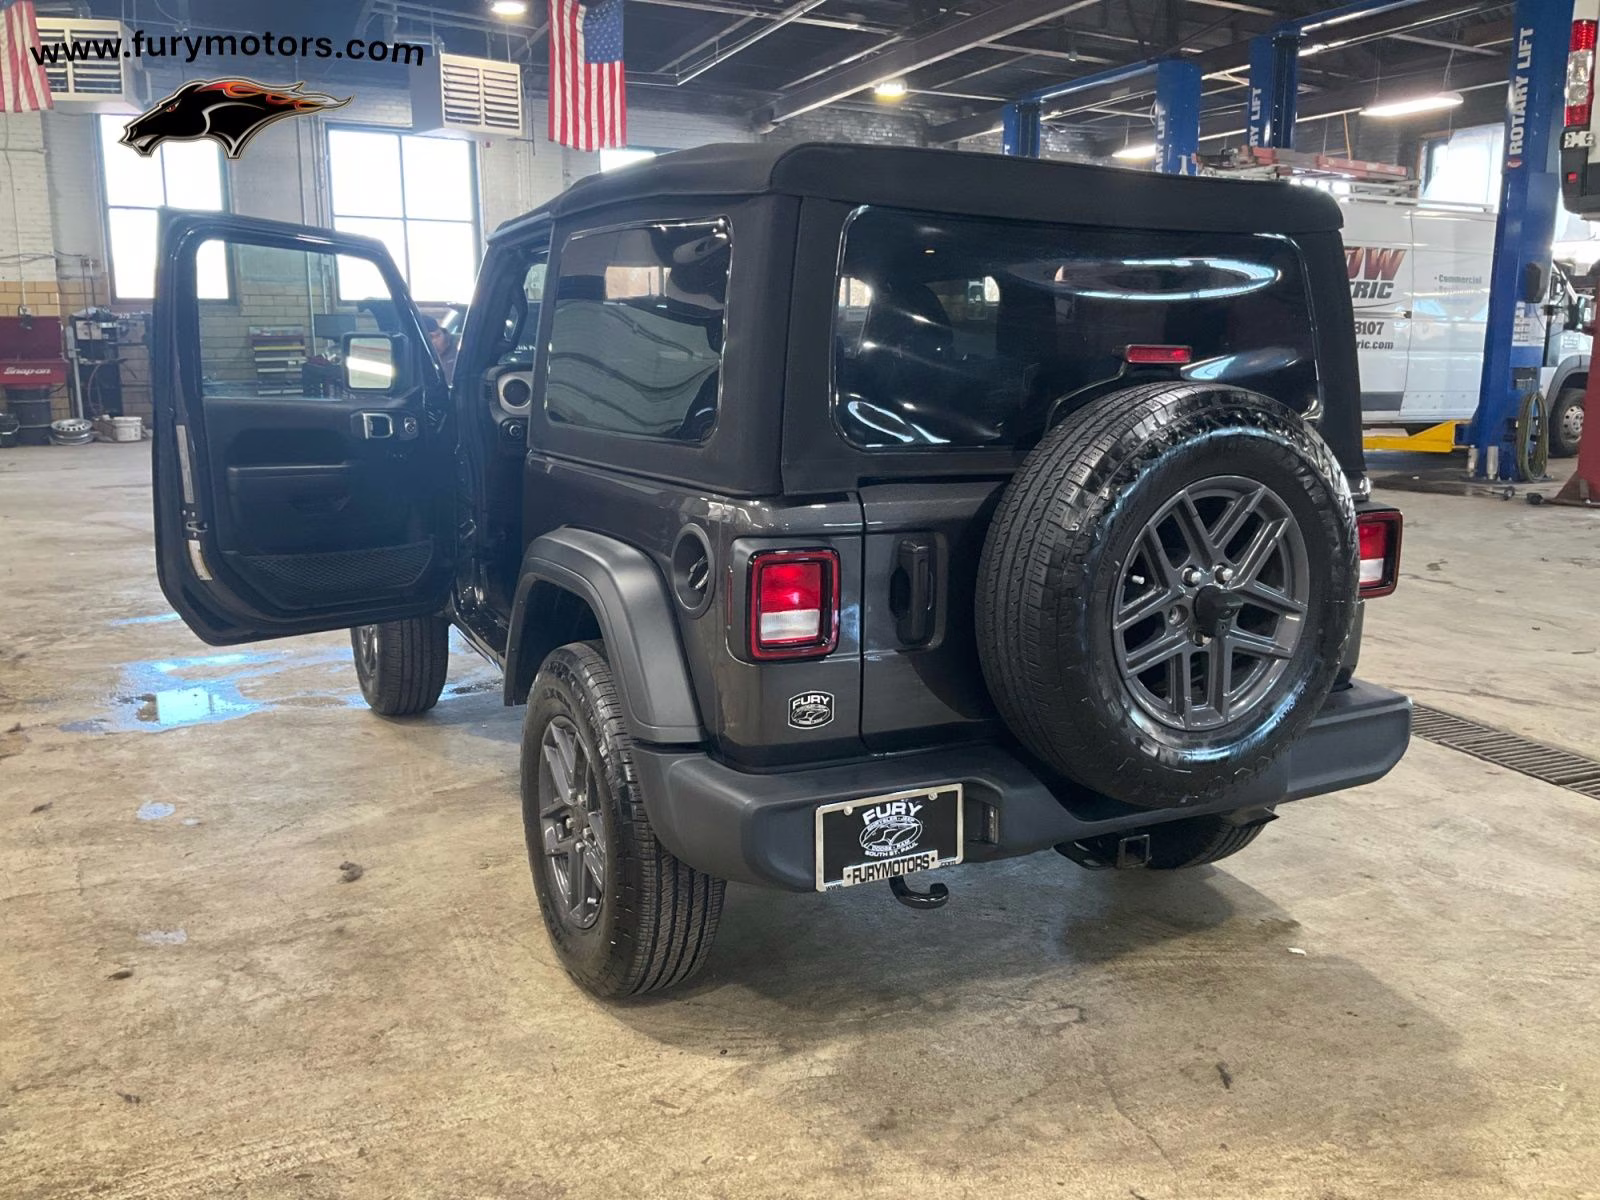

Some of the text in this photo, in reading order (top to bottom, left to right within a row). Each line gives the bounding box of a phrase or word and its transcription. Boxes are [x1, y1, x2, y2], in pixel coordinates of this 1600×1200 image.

[1250, 87, 1262, 121] LIFT
[1508, 27, 1535, 155] ROTARY LIFT
[1155, 143, 1164, 173] ARY
[1343, 246, 1407, 280] OW
[1356, 339, 1394, 350] ric.com
[3, 365, 52, 376] Snap-on
[792, 694, 830, 710] FURY
[862, 802, 923, 825] FURY
[901, 841, 919, 853] PAUL
[852, 854, 929, 884] FURYMOTORS
